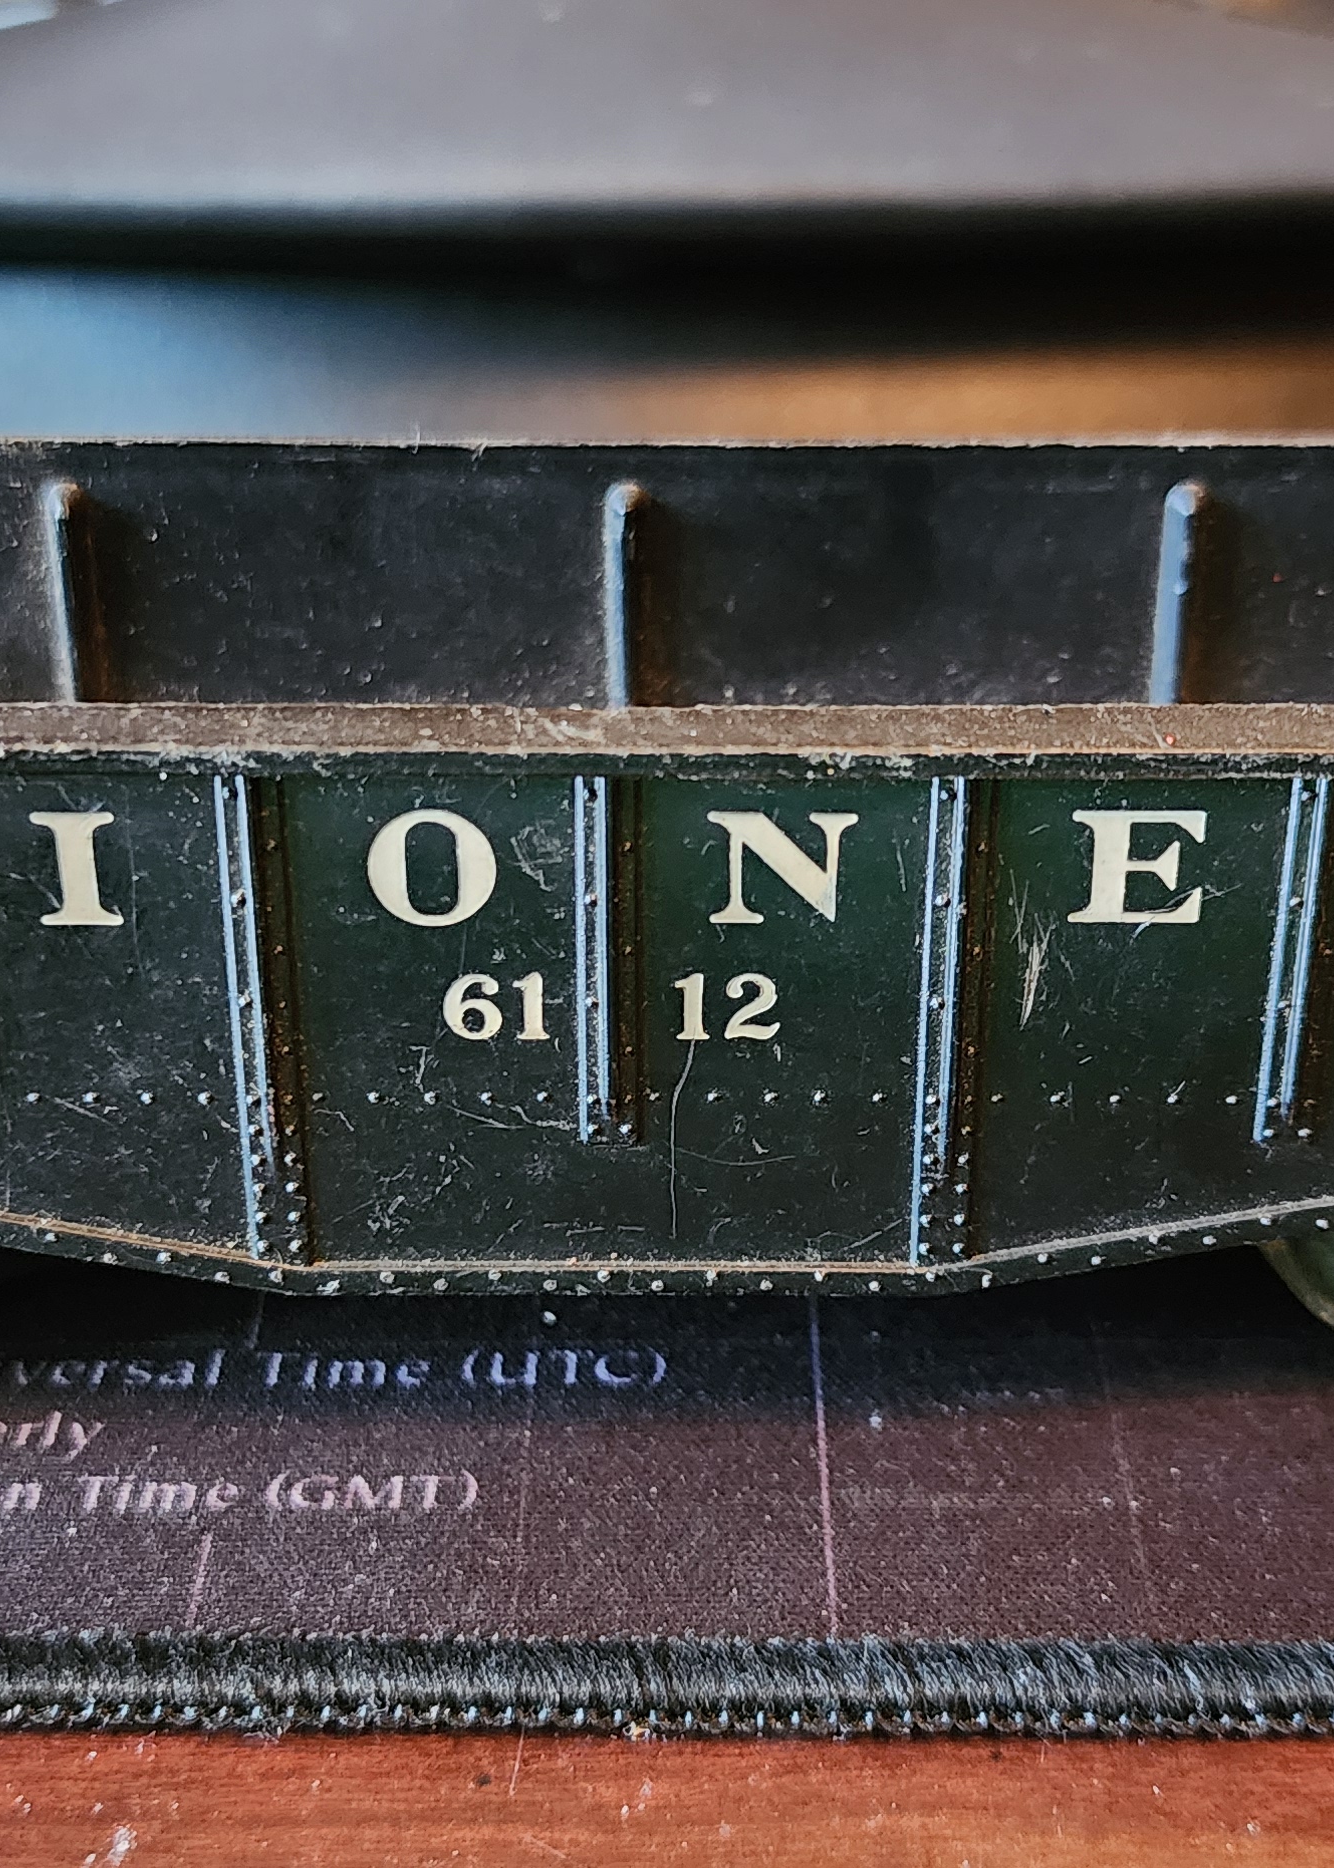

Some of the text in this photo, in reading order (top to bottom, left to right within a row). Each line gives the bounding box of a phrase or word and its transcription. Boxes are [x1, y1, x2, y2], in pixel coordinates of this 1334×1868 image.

[265, 1352, 431, 1389] Time
[463, 1350, 667, 1388] (UTC)
[75, 1474, 241, 1512] Time
[265, 1470, 479, 1512] (GMT)
